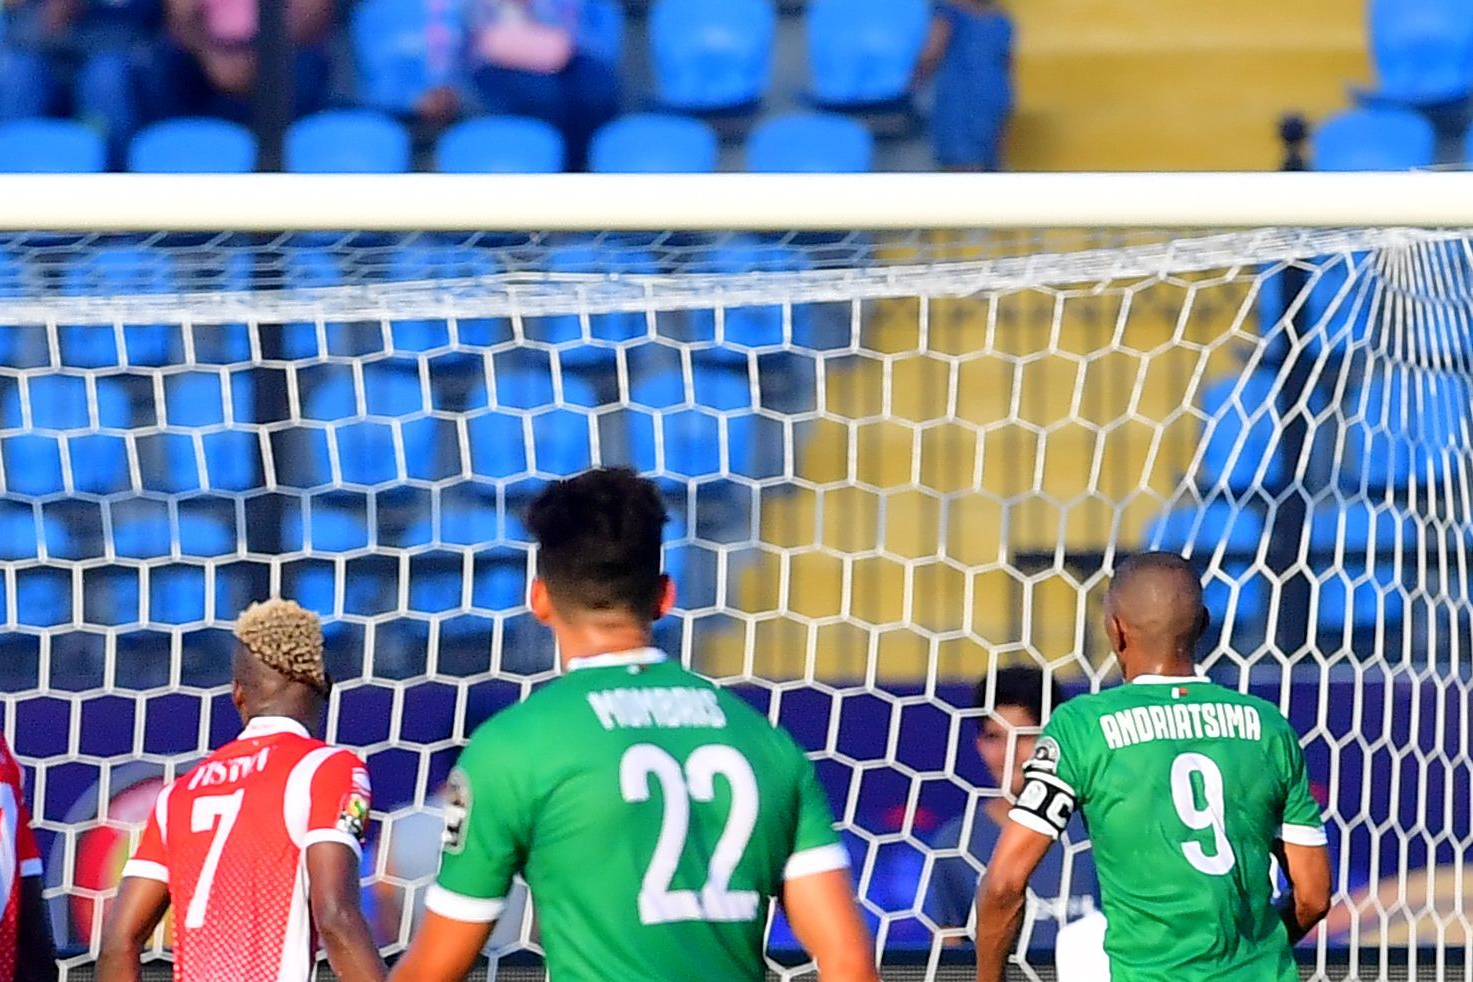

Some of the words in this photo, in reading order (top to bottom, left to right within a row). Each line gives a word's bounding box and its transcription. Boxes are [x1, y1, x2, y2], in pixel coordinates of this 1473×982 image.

[1100, 703, 1262, 749] ANDRIATSIMA
[185, 788, 245, 929] 7
[619, 743, 761, 926] 22
[1171, 751, 1236, 876] 9
